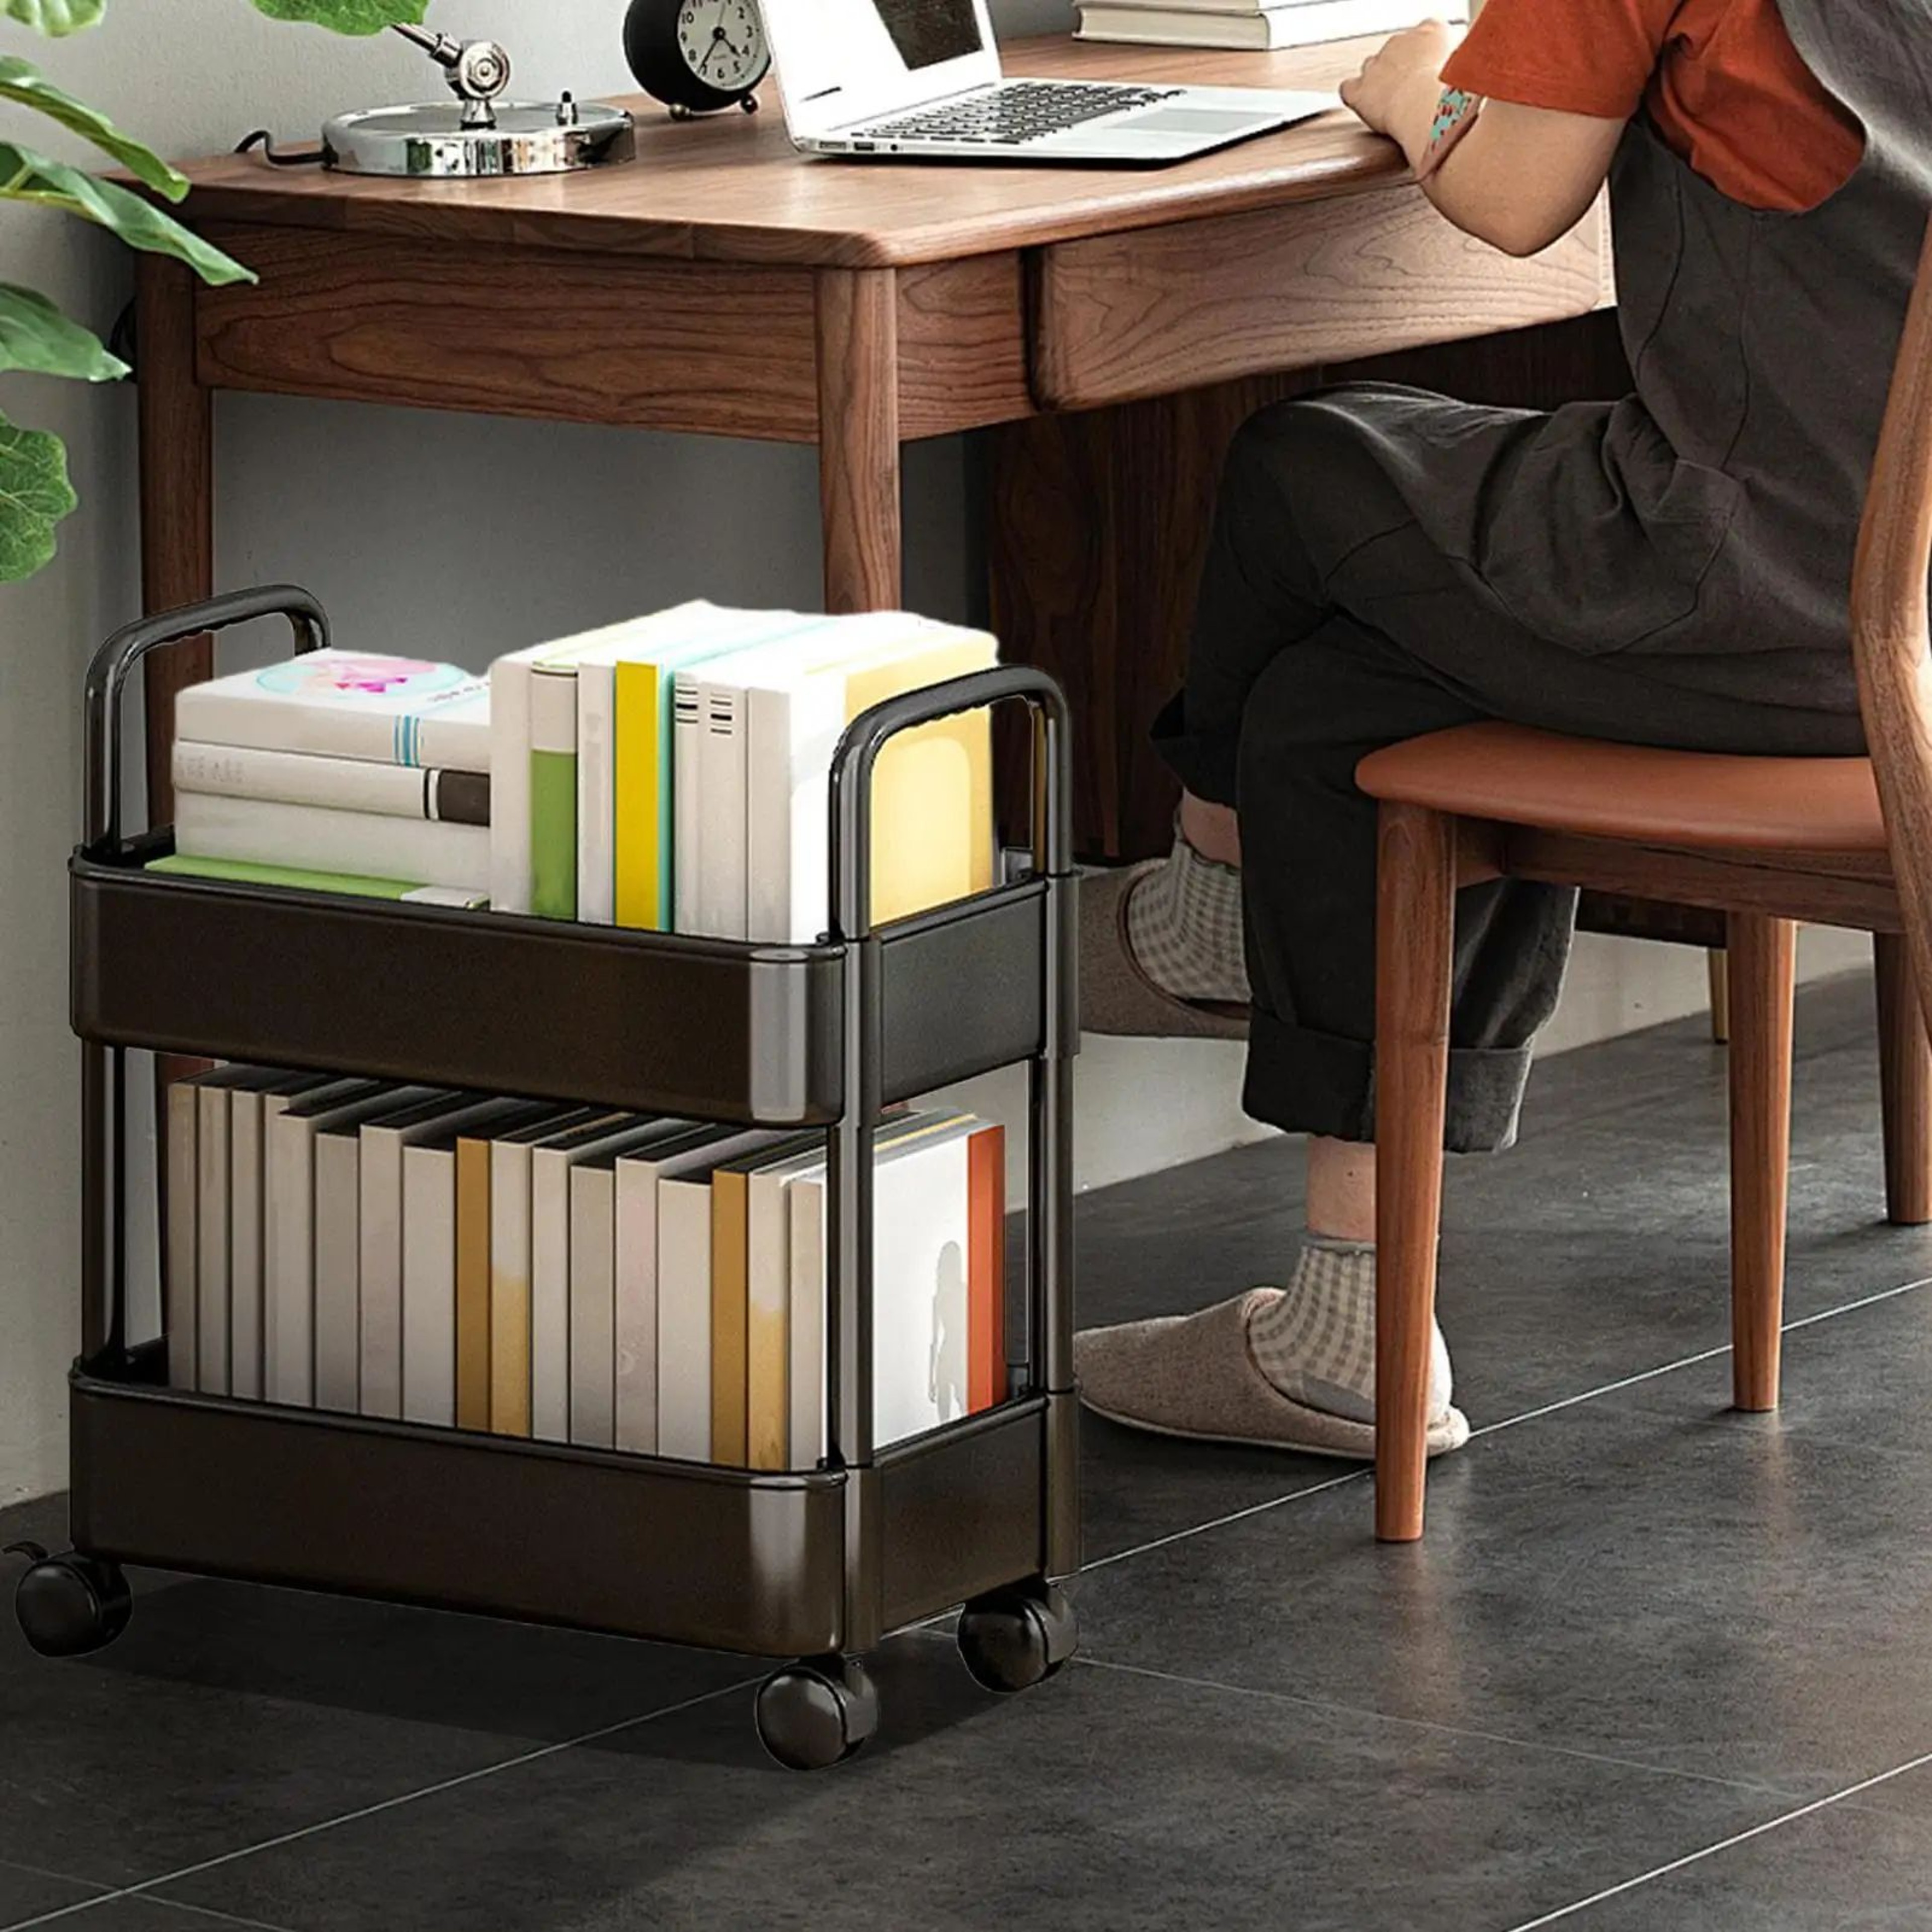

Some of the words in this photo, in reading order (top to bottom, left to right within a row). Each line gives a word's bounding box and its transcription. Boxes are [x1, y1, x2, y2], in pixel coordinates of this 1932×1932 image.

[682, 11, 694, 24] 10
[738, 7, 745, 20] 2
[680, 31, 687, 43] 9
[746, 25, 753, 38] 3
[688, 49, 696, 62] 8
[742, 44, 750, 56] 4
[717, 68, 725, 79] 6
[733, 60, 740, 74] 5
